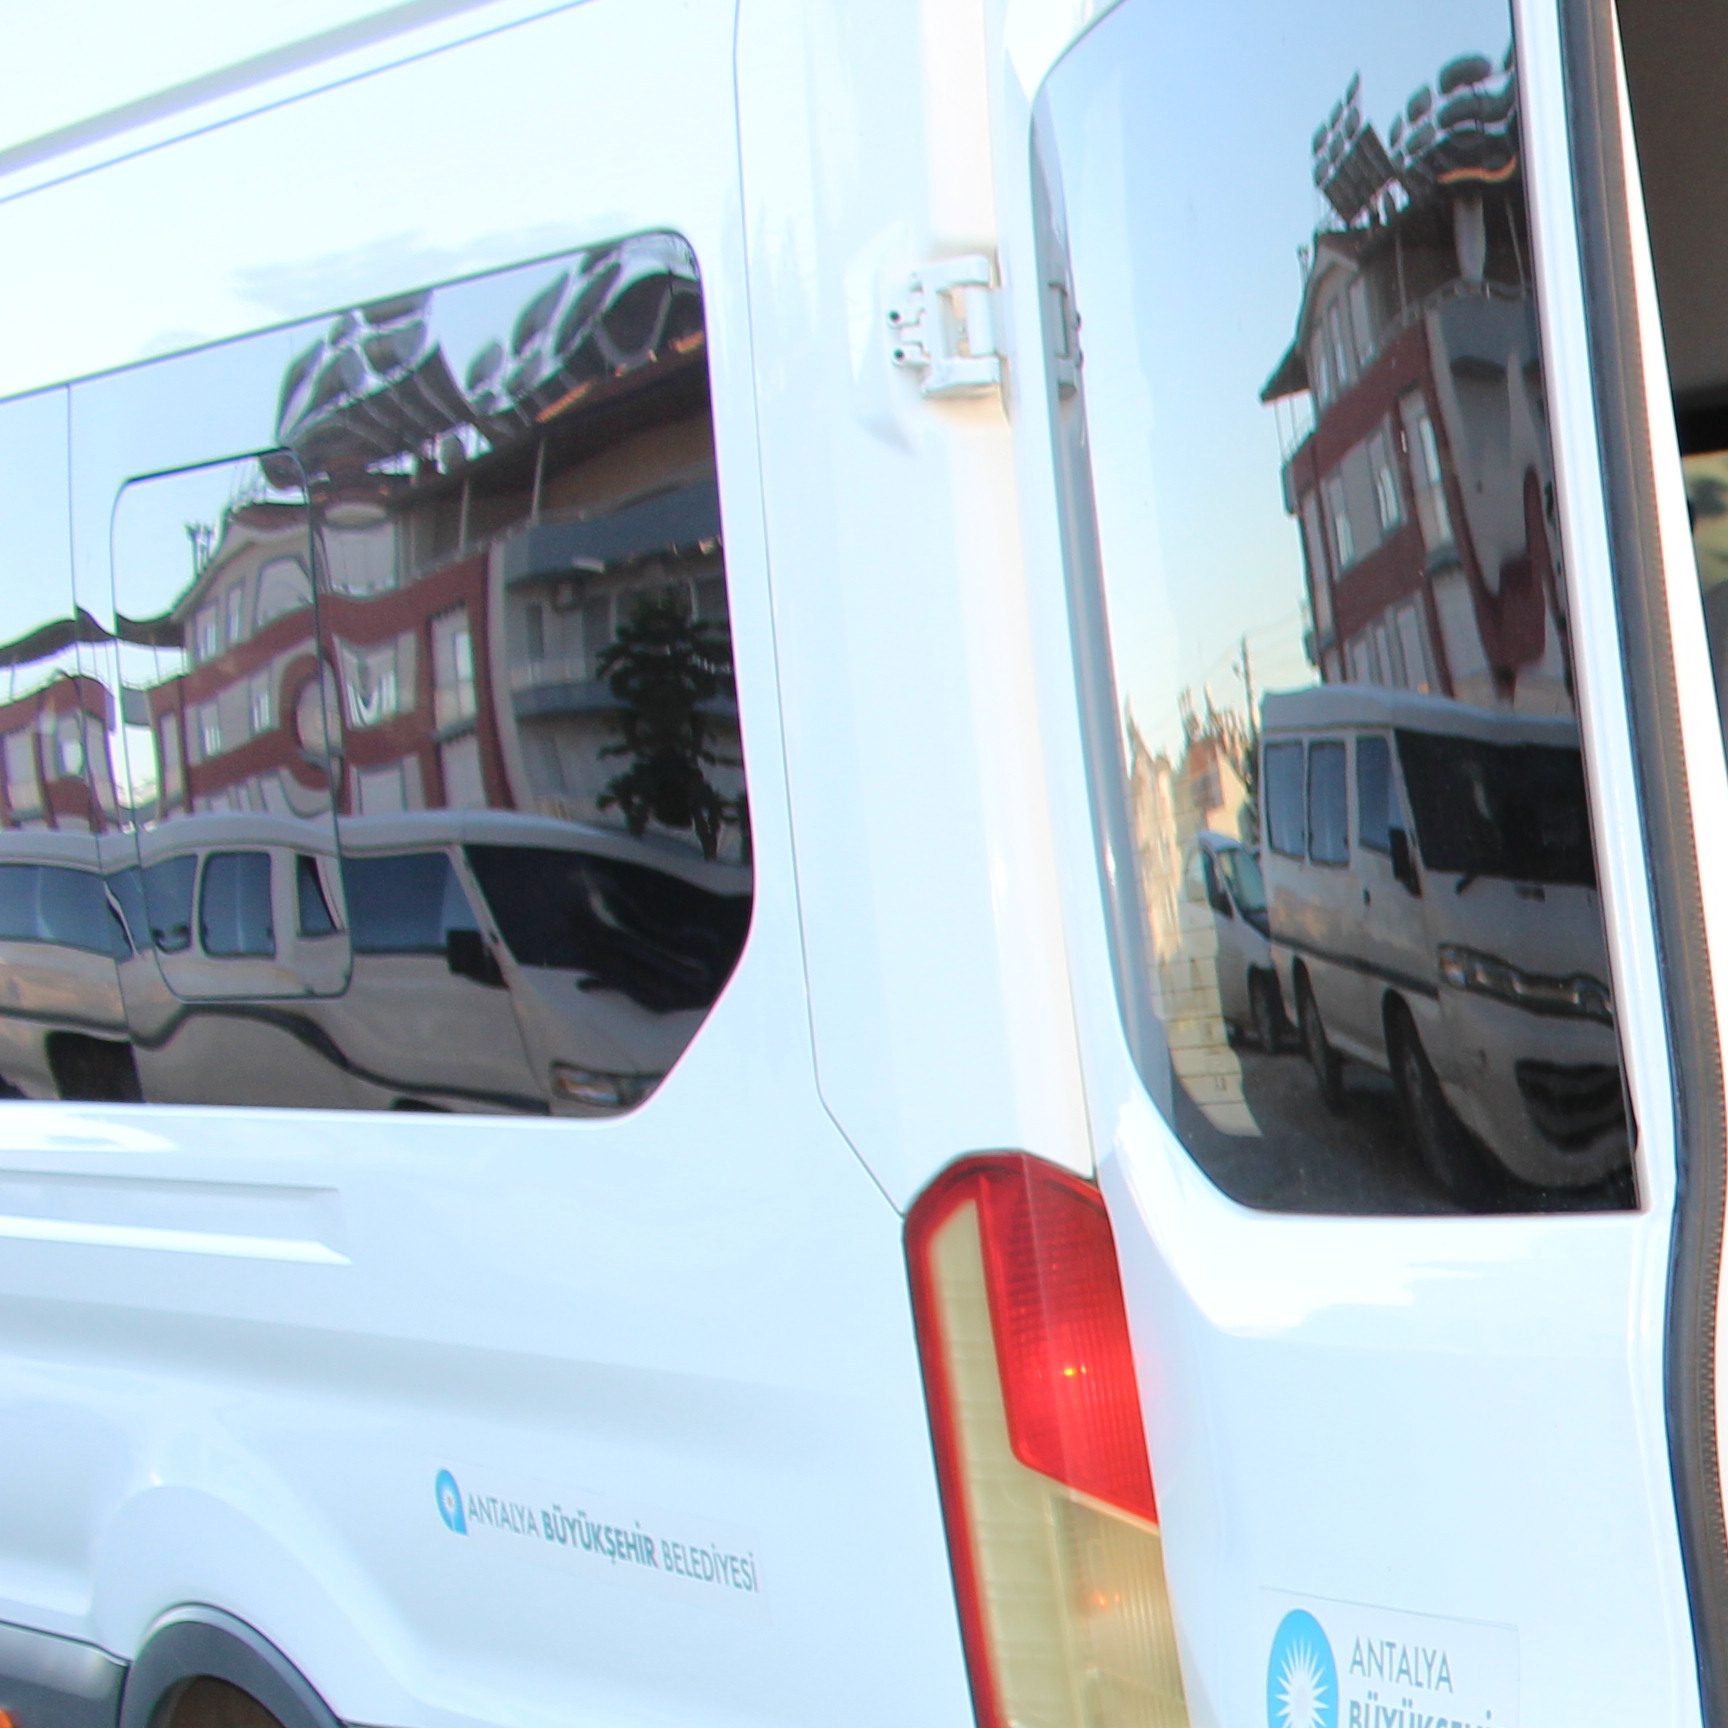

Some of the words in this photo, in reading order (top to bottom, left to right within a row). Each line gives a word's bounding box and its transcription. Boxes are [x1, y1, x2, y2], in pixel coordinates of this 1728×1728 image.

[467, 1494, 540, 1537] ANTALYA
[541, 1504, 659, 1568] BÜYÜKŞEHİR
[661, 1539, 759, 1592] BELEDİYESİ
[1349, 1634, 1453, 1694] ANTALYA
